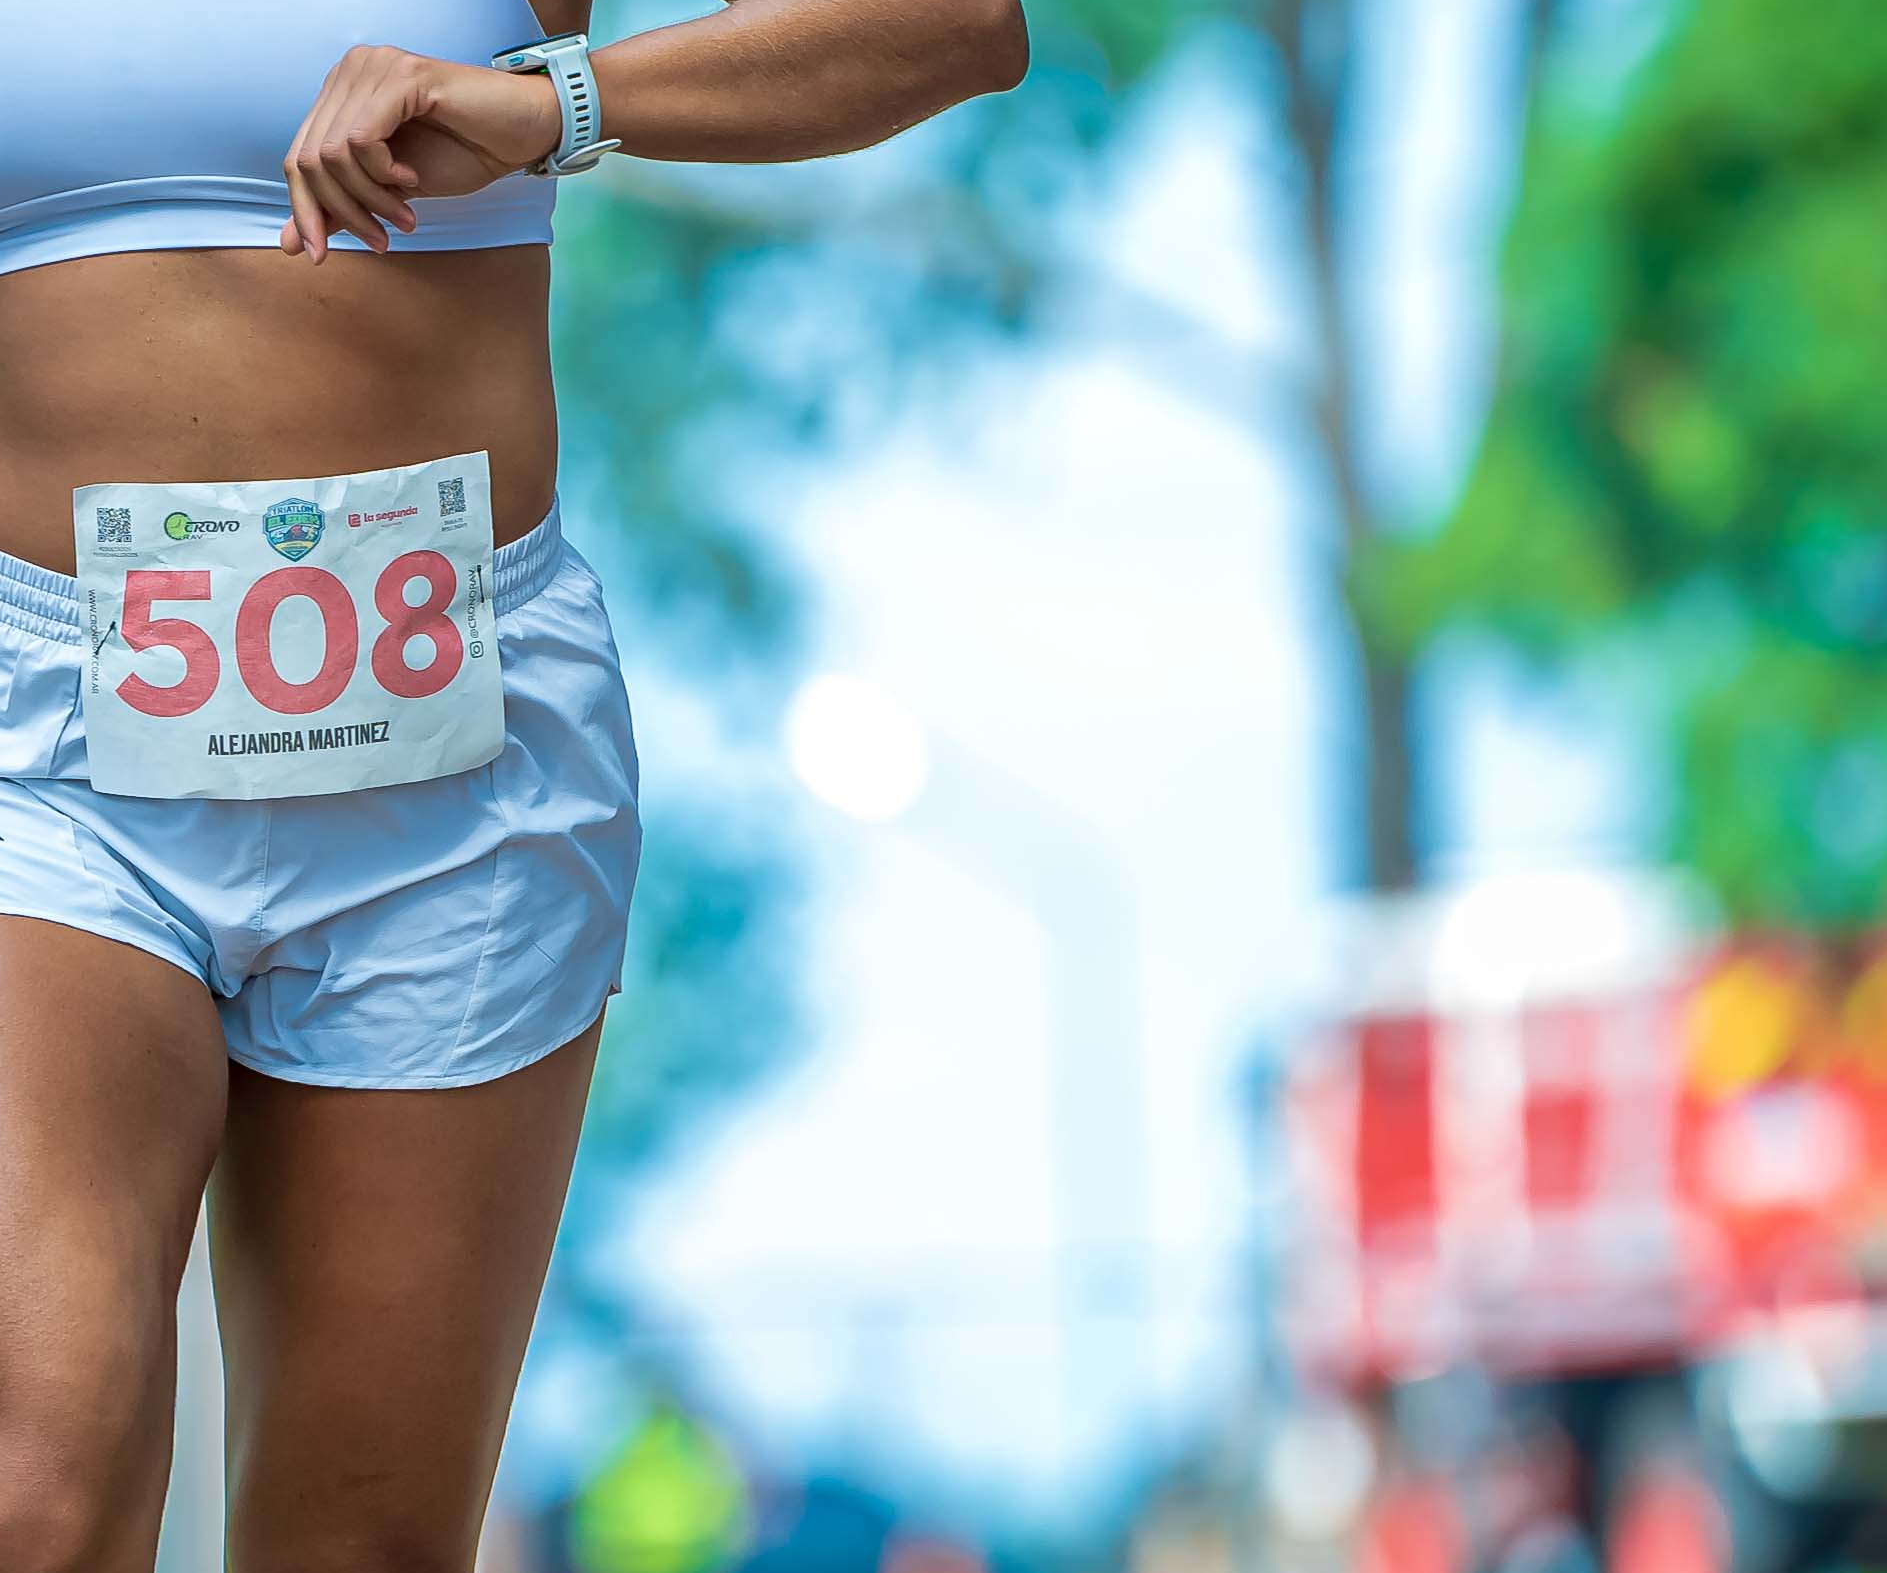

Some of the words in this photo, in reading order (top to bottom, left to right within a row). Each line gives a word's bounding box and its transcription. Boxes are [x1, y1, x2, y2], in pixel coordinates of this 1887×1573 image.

[272, 505, 315, 516] TRIATLON
[364, 513, 374, 522] la
[376, 506, 418, 522] segunda
[184, 521, 240, 533] CRONO
[467, 569, 479, 639] @CRONORAV
[115, 549, 464, 718] 508
[207, 730, 305, 756] ALEJANDRA
[308, 720, 390, 751] MARTINEZ
